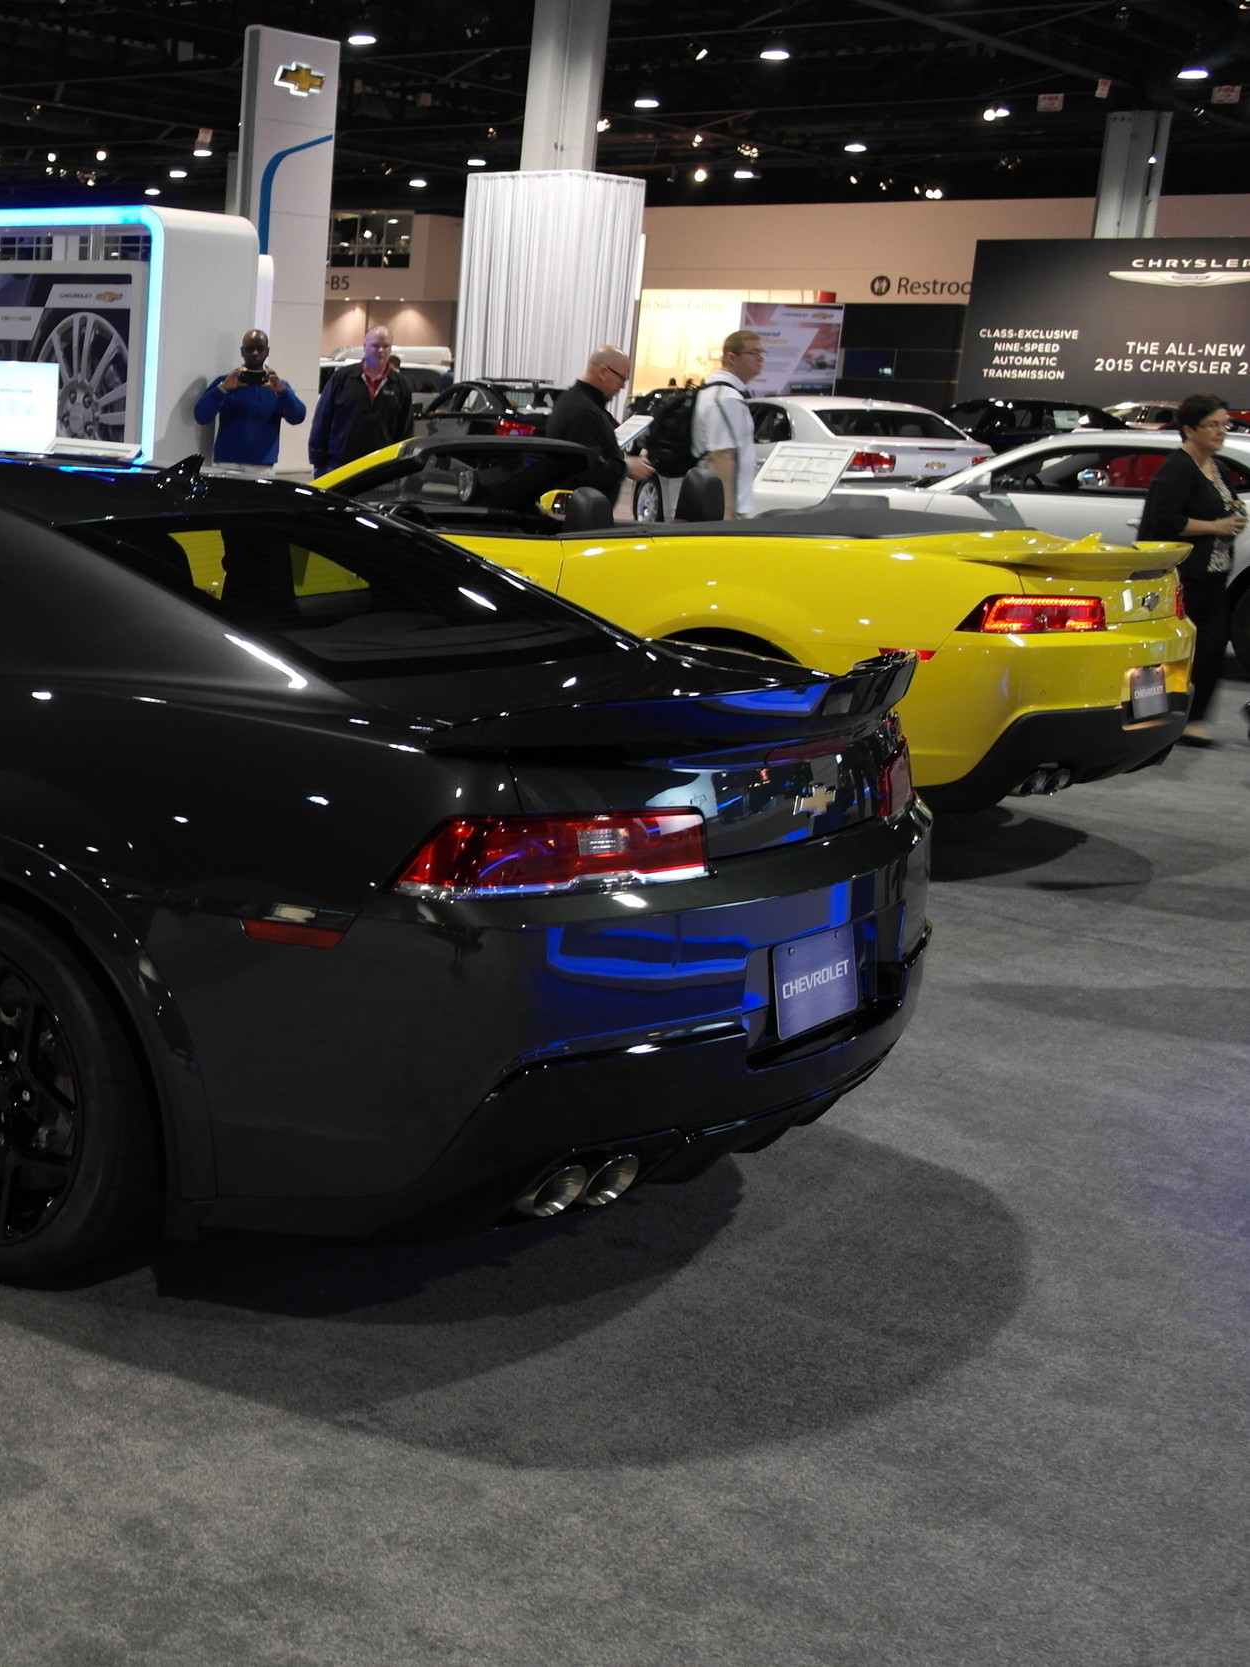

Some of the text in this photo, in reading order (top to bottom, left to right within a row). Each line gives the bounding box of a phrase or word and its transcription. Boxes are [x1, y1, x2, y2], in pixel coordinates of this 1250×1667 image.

[979, 328, 1079, 340] CLASS-EXCLUSIVE
[993, 342, 1060, 353] NINE-SPEED
[1126, 341, 1246, 357] THE ALL-NEW
[992, 355, 1058, 367] AUTOMATIC
[1094, 358, 1250, 375] 2015 CHRYSLER 2
[982, 368, 1065, 380] TRANSMISSION
[782, 959, 849, 999] CHEVROLET
